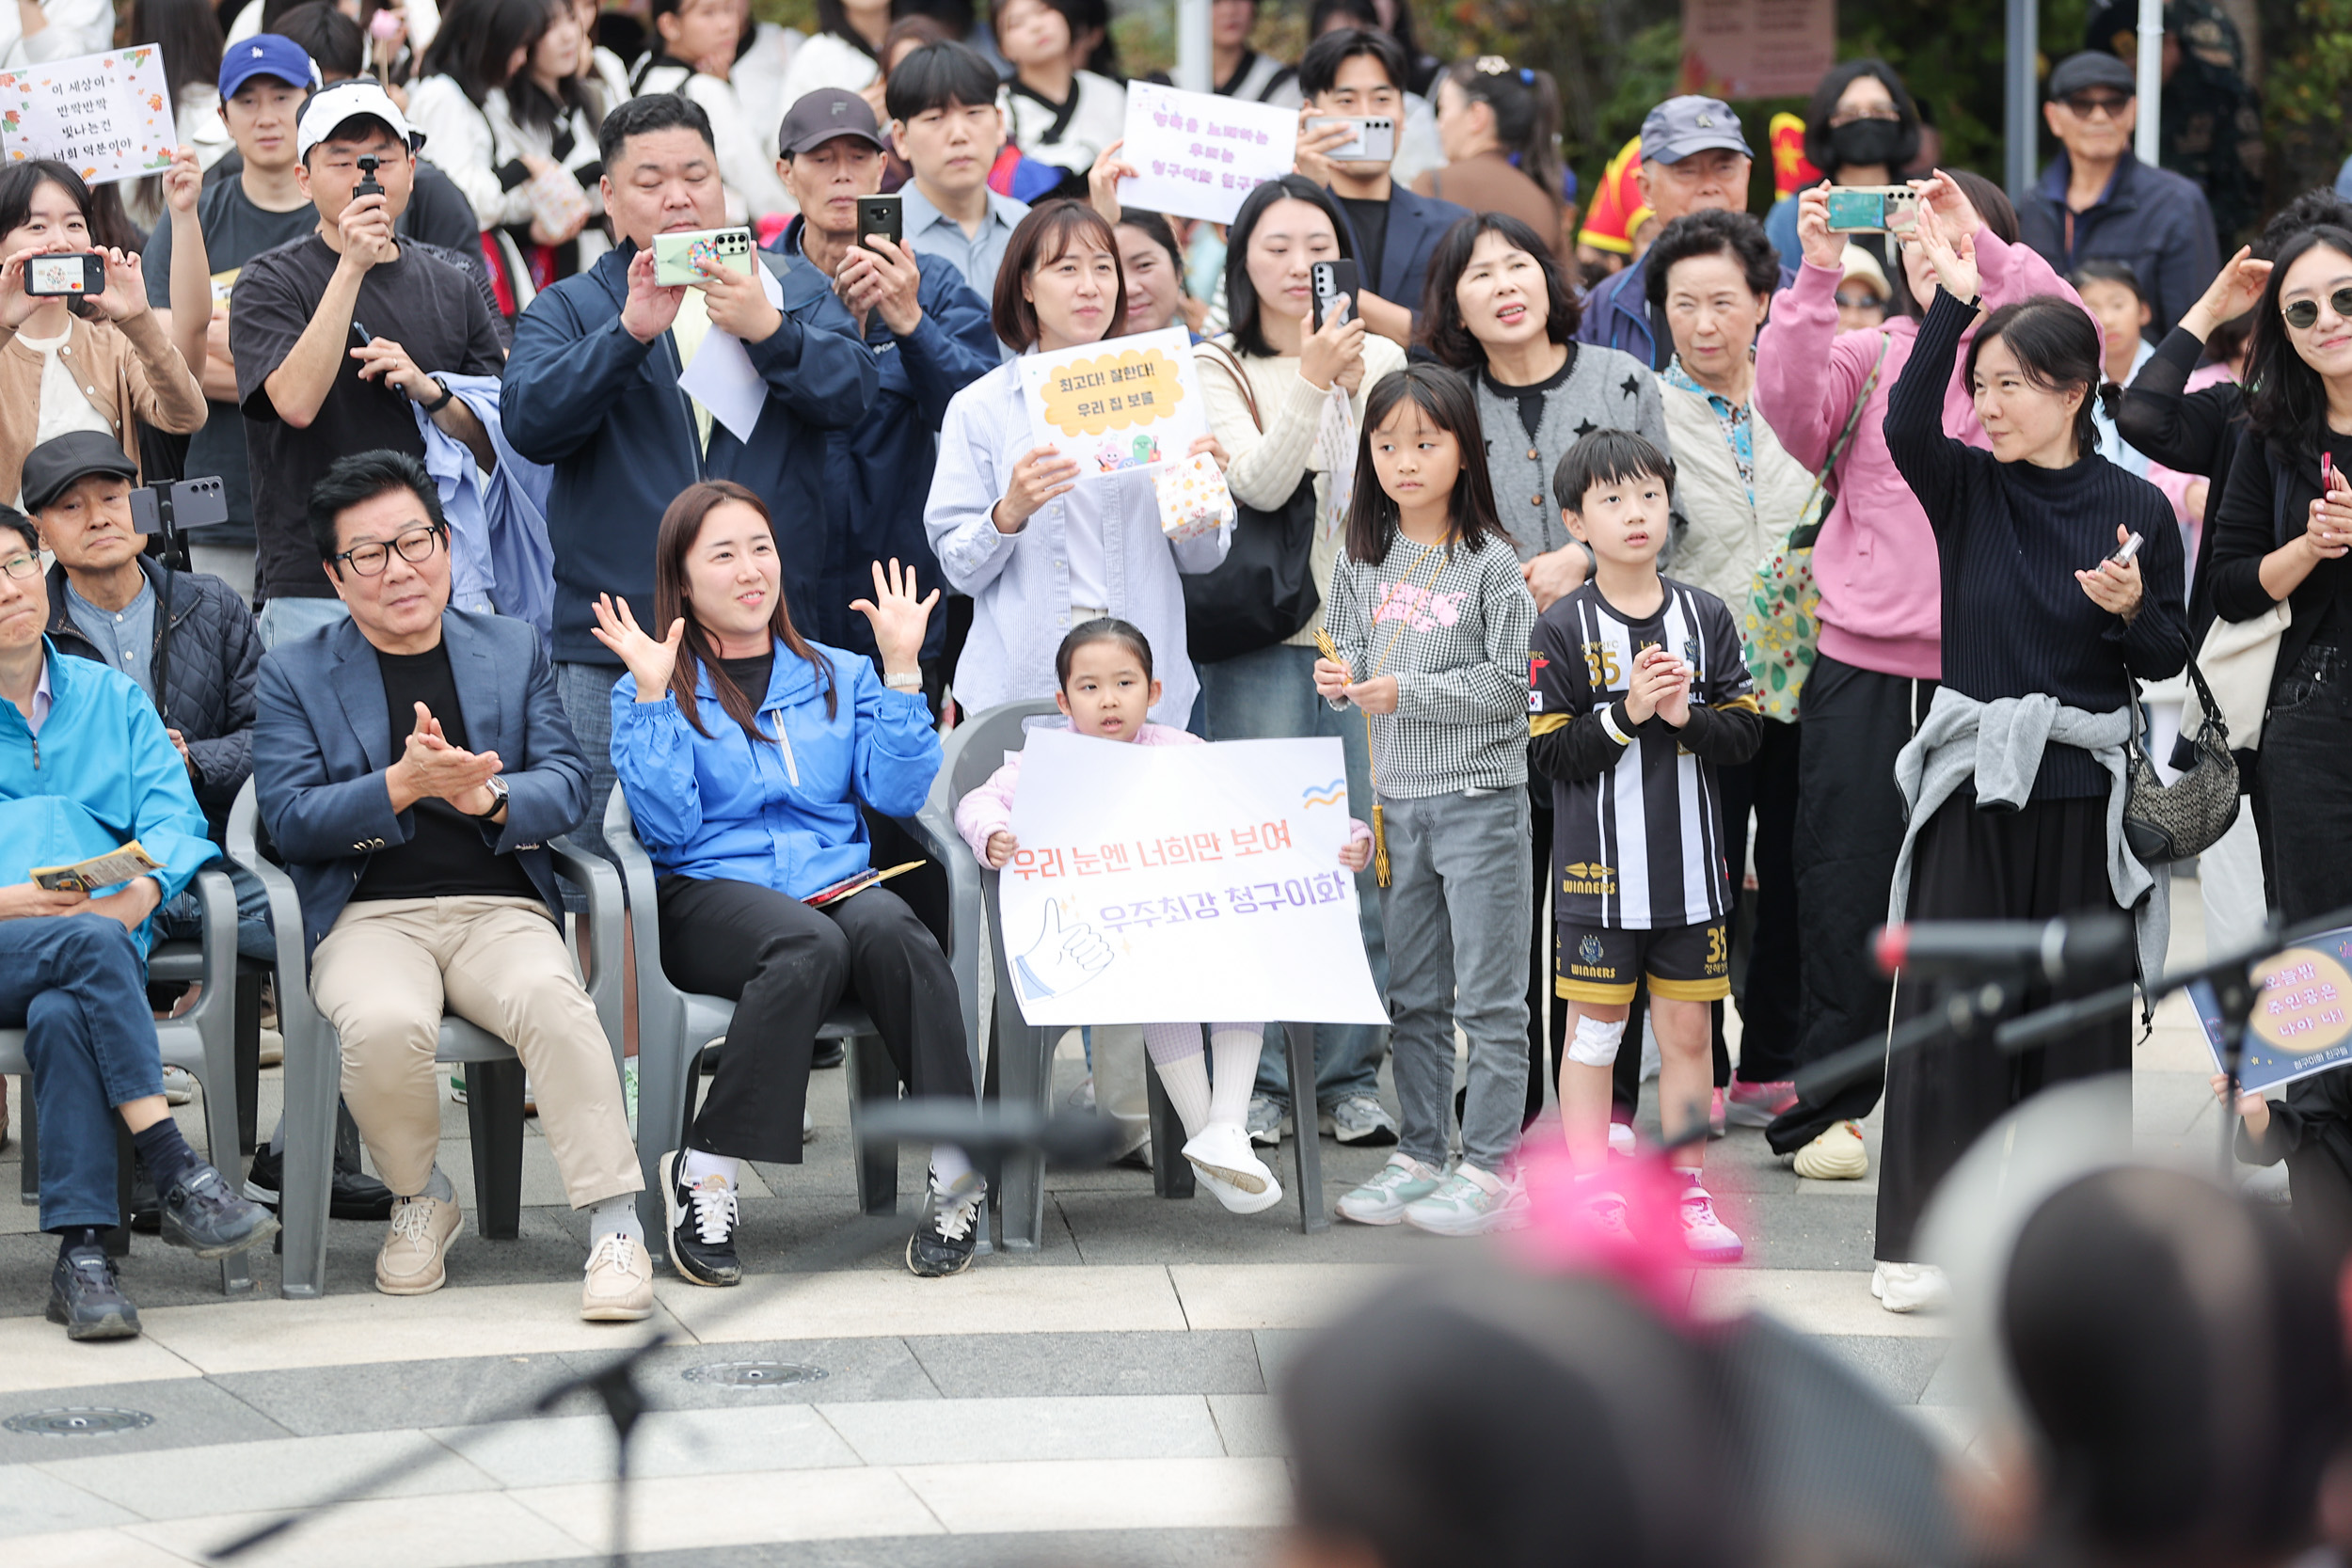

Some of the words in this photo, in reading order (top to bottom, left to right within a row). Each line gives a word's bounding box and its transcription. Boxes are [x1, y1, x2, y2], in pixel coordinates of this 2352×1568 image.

[52, 83, 63, 95] 이
[69, 75, 105, 93] 세상이
[56, 97, 108, 119] 반짝반짝
[61, 119, 113, 140] 빛나는건
[53, 147, 78, 163] 너희
[83, 137, 133, 157] 덕분이야
[1189, 142, 1235, 164] 우리는
[1059, 372, 1105, 393] 최고다!
[1110, 362, 1155, 384] 잘한다!
[1077, 400, 1105, 418] 우리
[1109, 396, 1124, 412] 집
[1127, 390, 1154, 408] 보물
[1584, 651, 1621, 687] 35
[1013, 847, 1066, 880] 우리
[1072, 843, 1131, 876] 눈엔
[1136, 832, 1223, 867] 너희만
[1231, 819, 1292, 857] 보여
[1563, 879, 1616, 895] WINNERS
[1099, 892, 1220, 933] 우주최강
[1224, 870, 1345, 913] 청구이화
[1706, 925, 1727, 964] 35
[1570, 963, 1616, 979] WINNERS
[2265, 962, 2315, 990] 오늘밤
[2267, 983, 2338, 1015] 주인공은
[2279, 1016, 2315, 1037] 나야
[2320, 1007, 2344, 1024] 나!
